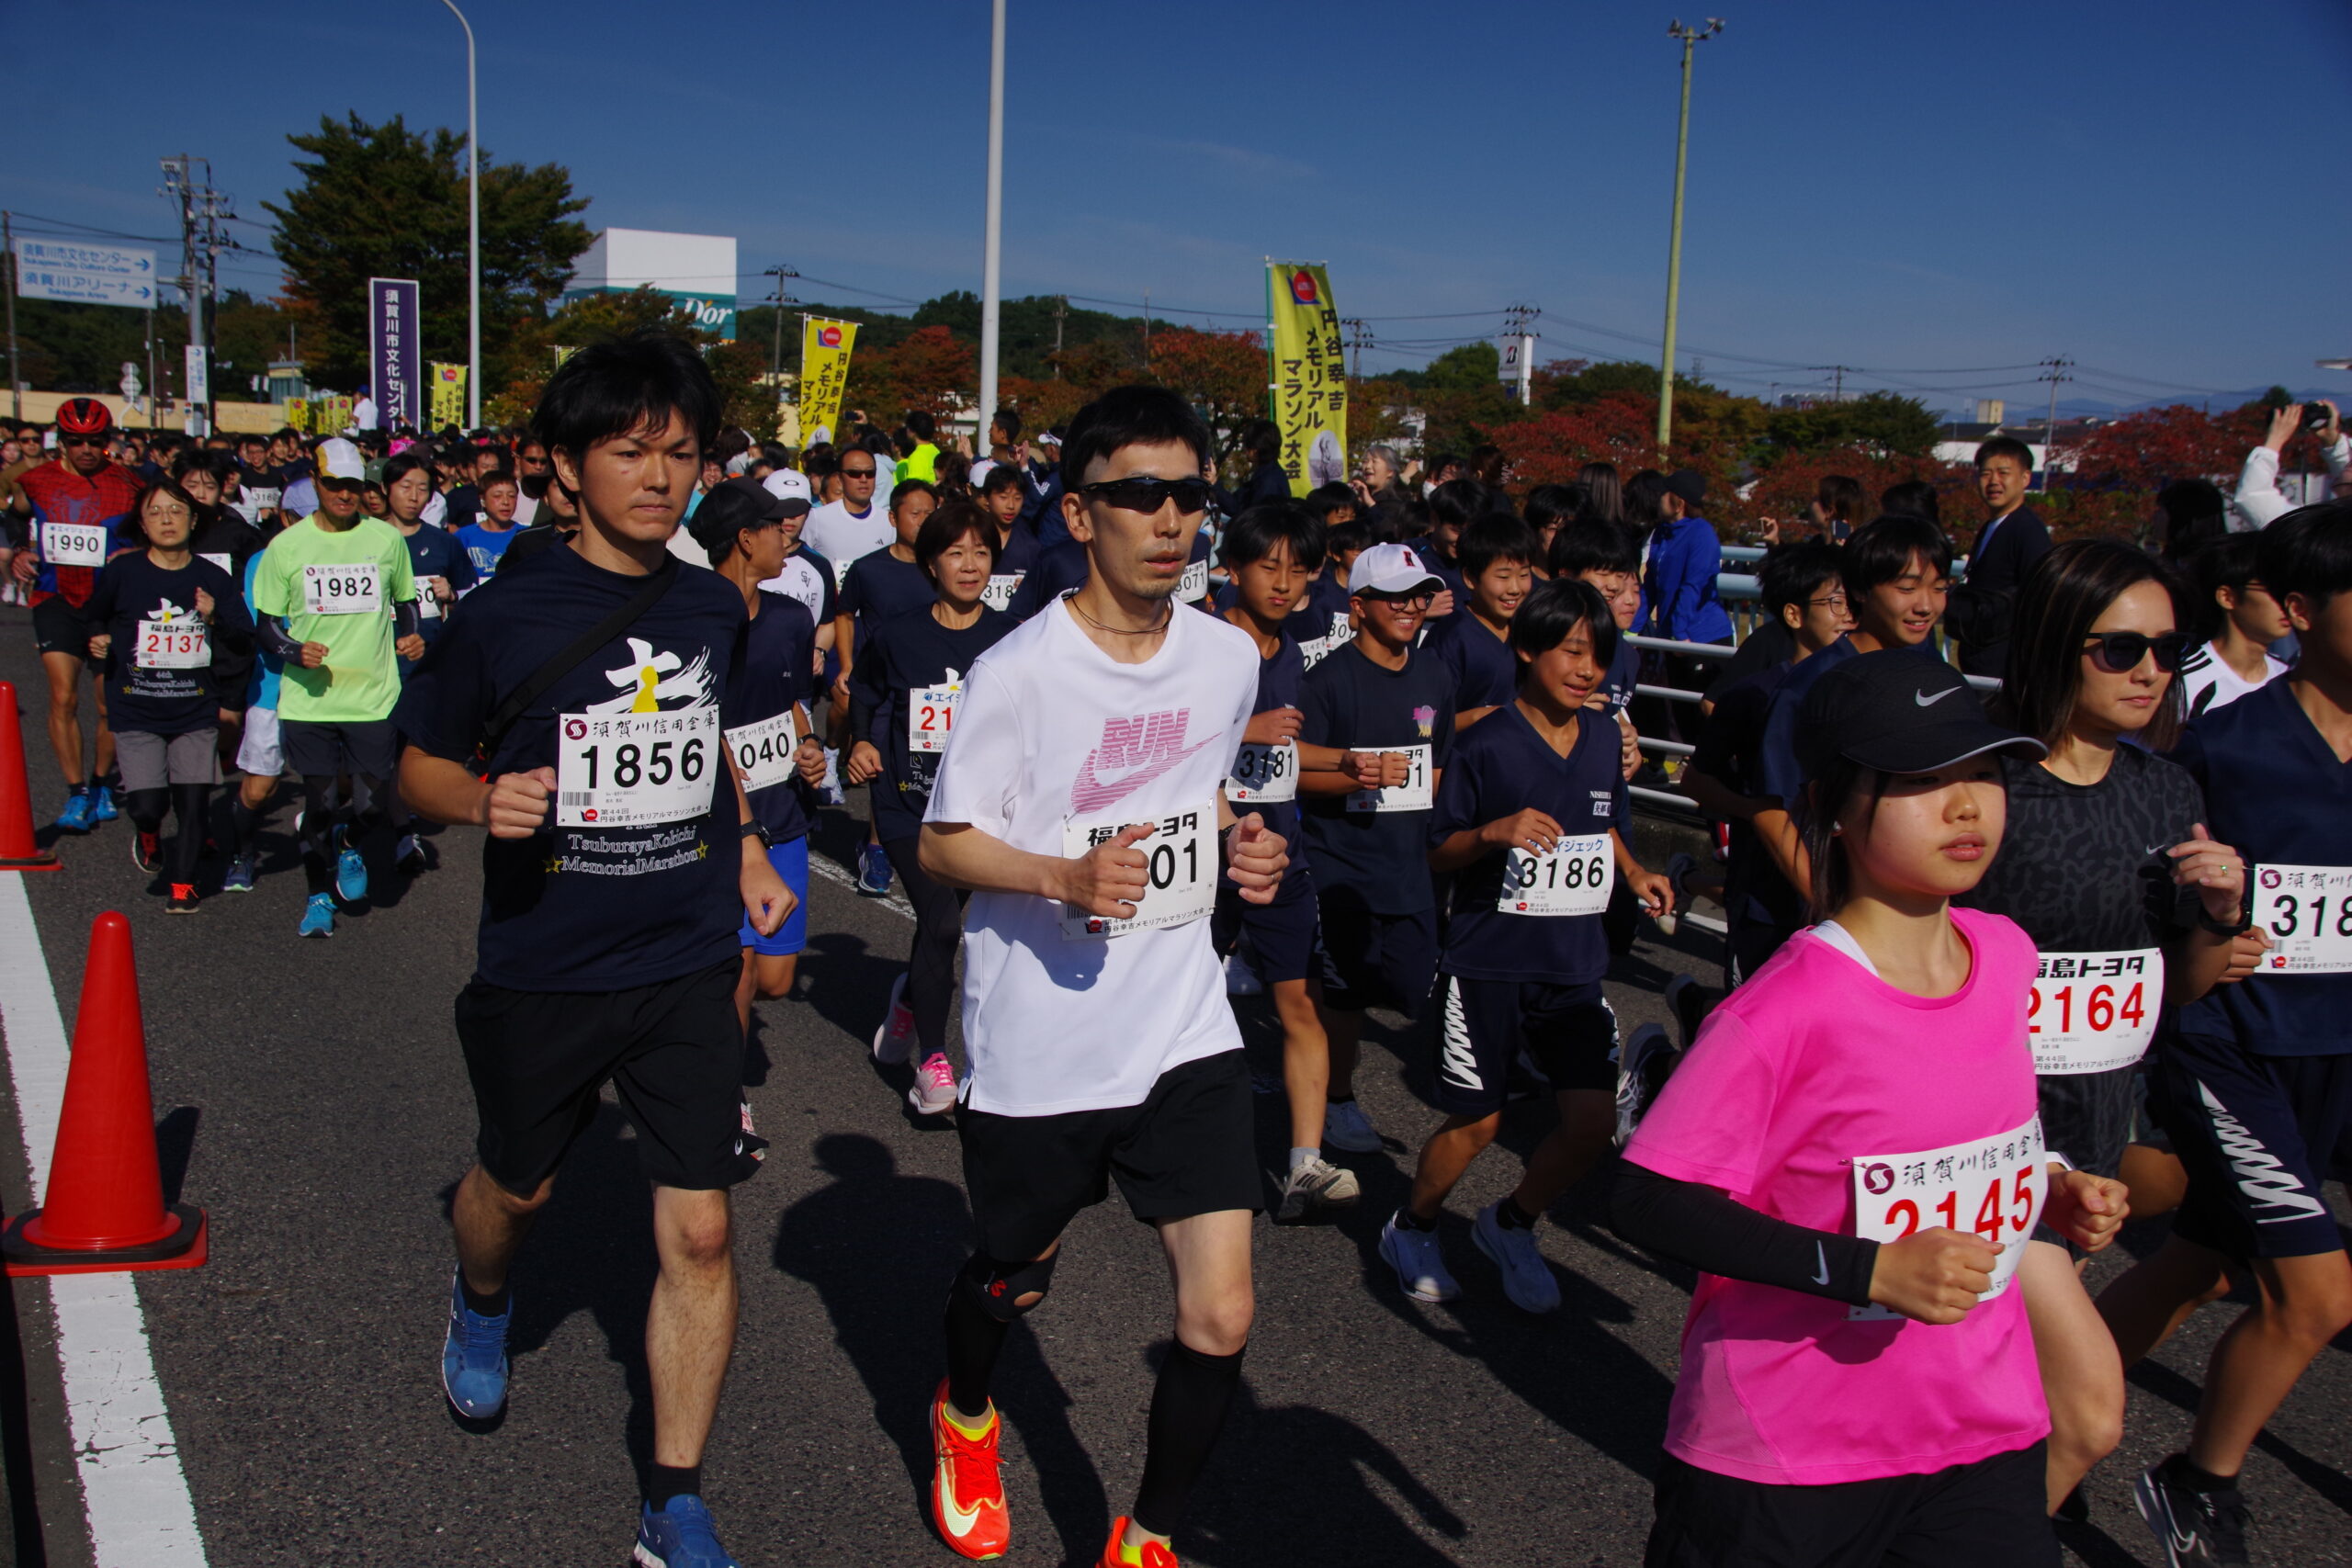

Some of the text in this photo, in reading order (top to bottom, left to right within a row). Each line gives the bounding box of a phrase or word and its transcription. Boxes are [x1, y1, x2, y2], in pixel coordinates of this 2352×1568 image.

[23, 243, 131, 264] 須賀川市文化センター
[64, 261, 77, 271] City
[24, 271, 131, 293] 須賀川アリーナ
[87, 290, 109, 299] Arena
[385, 289, 401, 433] 須賀川市文化センター
[1321, 309, 1344, 412] 円谷幸吉
[1305, 327, 1324, 430] メモリアル
[809, 362, 832, 425] メモリアル
[1283, 359, 1303, 479] マラソン大会
[50, 534, 98, 552] 1990
[313, 576, 373, 597] 1982
[415, 587, 435, 604] 60
[984, 585, 1013, 599] 318
[151, 624, 205, 633] 福島トヨタ
[147, 634, 205, 653] 2137
[593, 712, 715, 739] 須賀川信用金庫
[920, 705, 952, 731] 21
[740, 732, 789, 770] 040
[1094, 706, 1191, 771] RUN
[581, 738, 705, 789] 1856
[1238, 750, 1293, 779] 3181
[600, 806, 702, 823] 円谷幸吉メモリアルマラソン大会
[601, 807, 629, 816] 第44回
[568, 825, 697, 856] TsuburayaKokichi
[1088, 812, 1198, 847] 福ヨタ
[561, 849, 699, 875] MemorialMarathon
[1149, 838, 1197, 890] 01
[1518, 856, 1604, 889] 3186
[1103, 908, 1204, 933] 円谷幸吉メモリアルマラソン大会
[2029, 982, 2145, 1033] 2164
[2035, 1054, 2137, 1070] 円谷幸吉メモリアルマラソン大会
[1885, 1164, 2033, 1244] 2145
